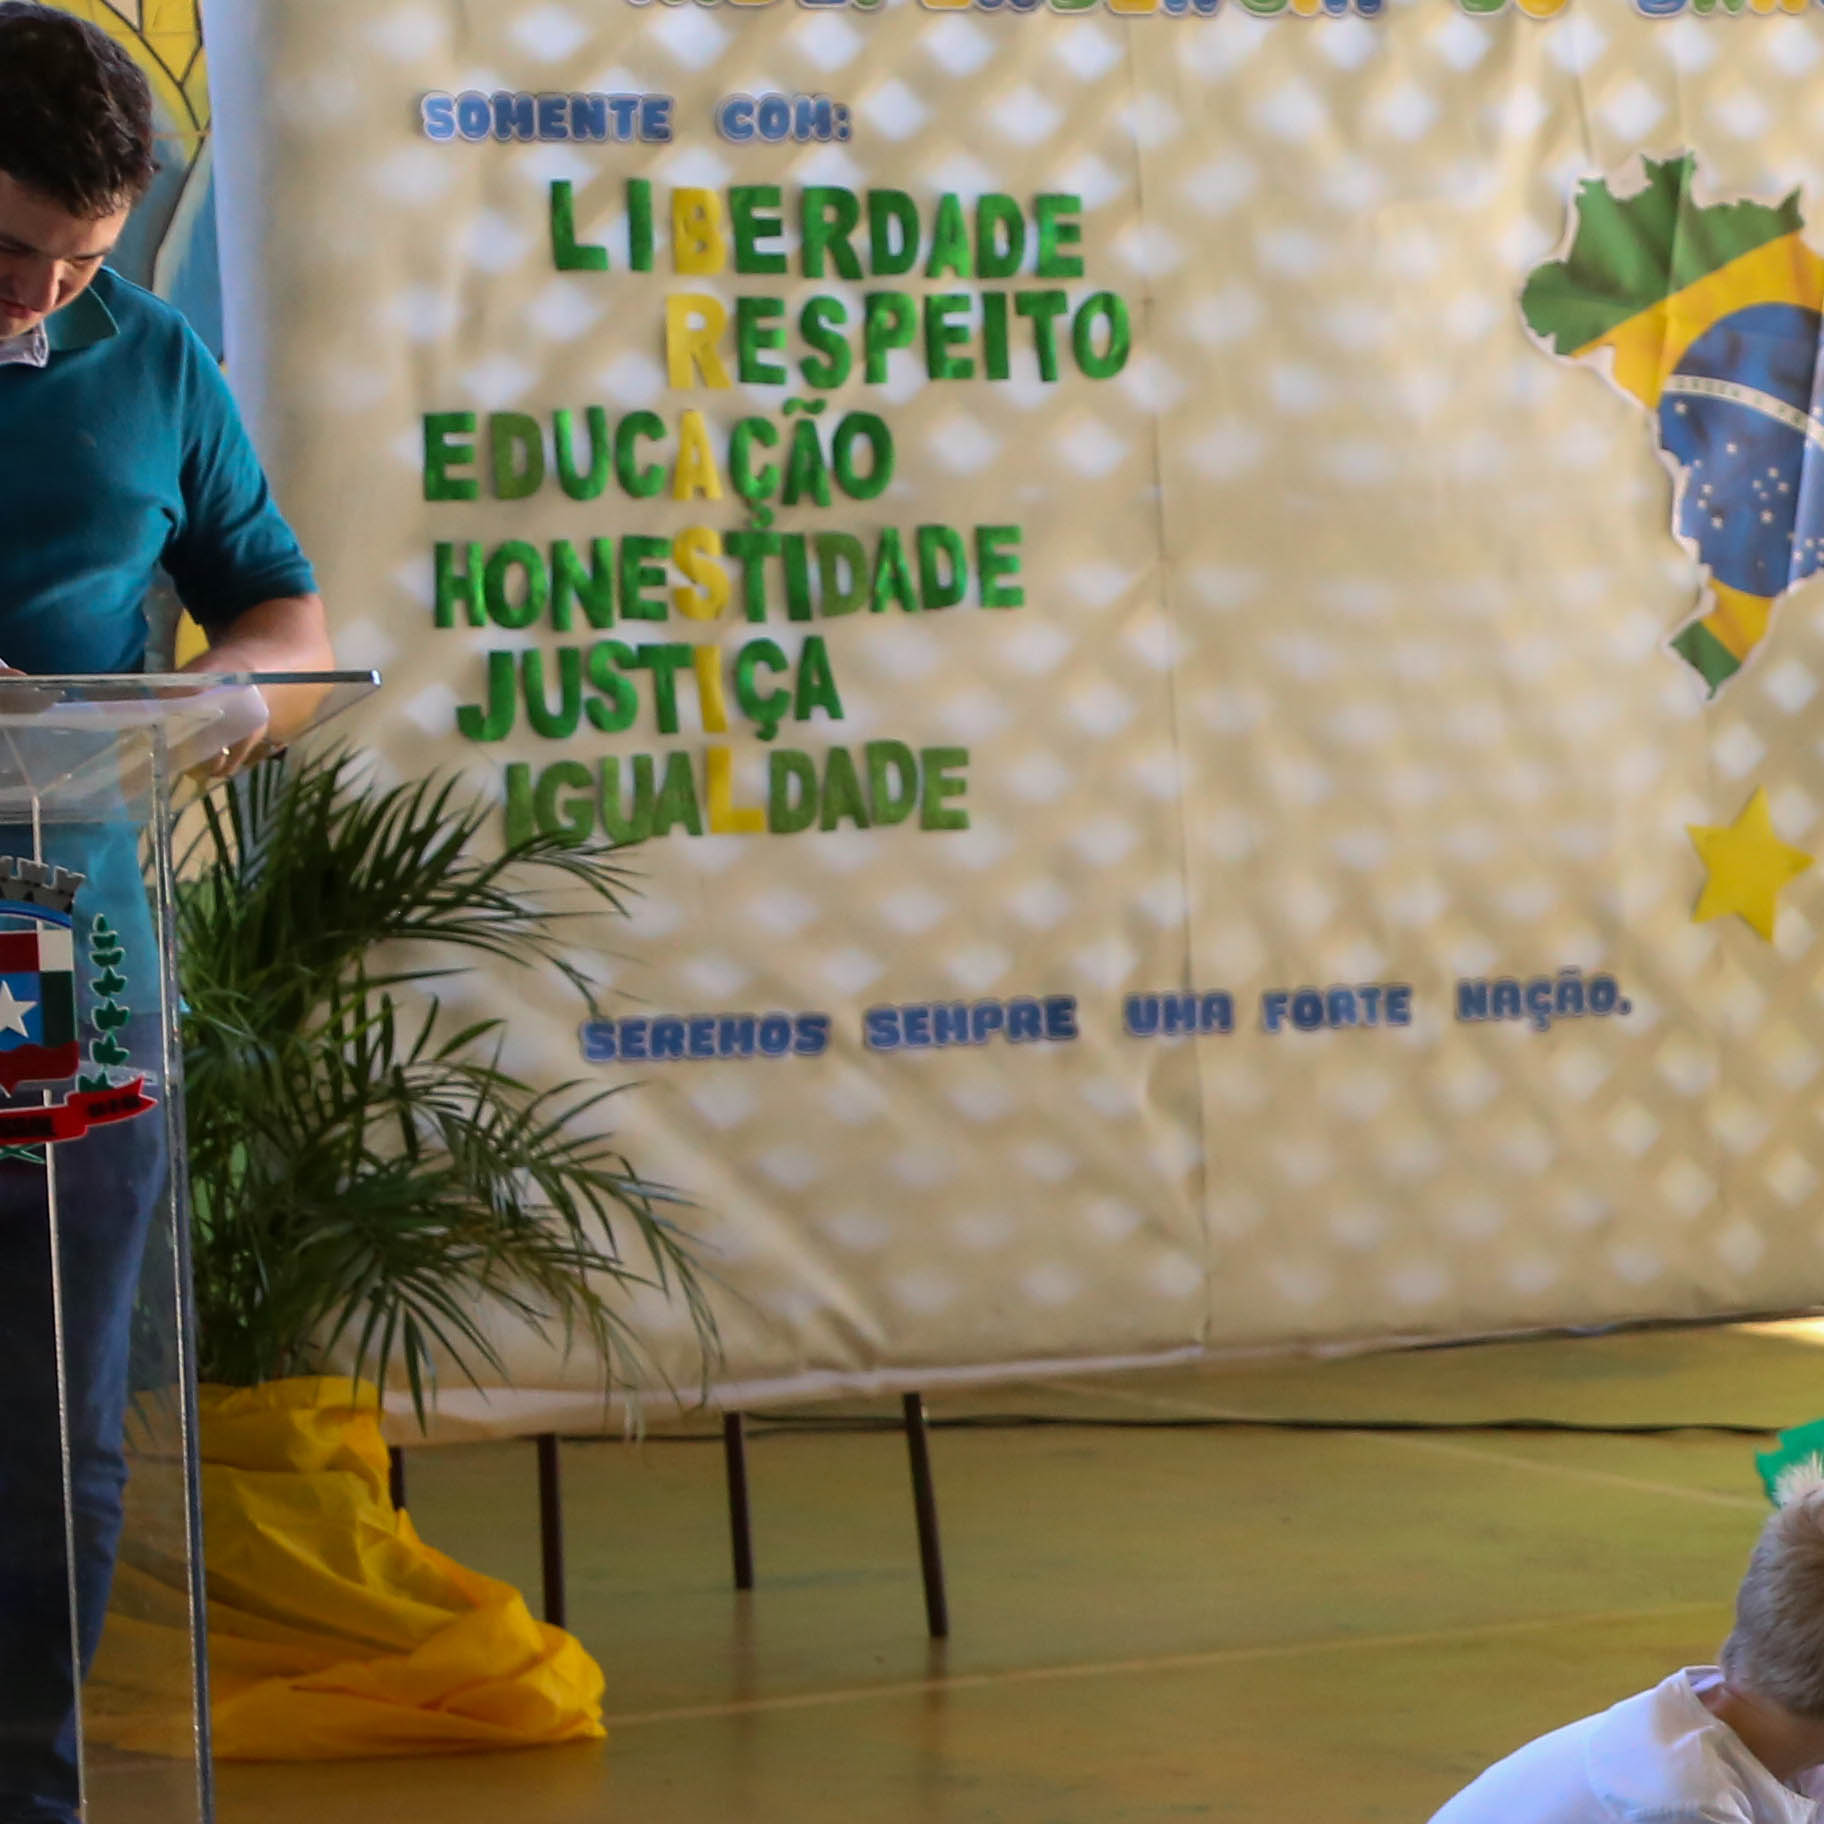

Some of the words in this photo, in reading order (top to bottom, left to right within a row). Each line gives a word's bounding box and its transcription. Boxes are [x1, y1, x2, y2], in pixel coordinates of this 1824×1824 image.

[420, 90, 673, 143] SOMENTE
[715, 92, 853, 143] COM:
[549, 178, 1085, 281] LIBERDADE
[666, 289, 1131, 390] RESPEITO
[422, 397, 896, 529] EDUCAÇÃO
[433, 524, 1026, 631] HONESTIDADE
[456, 634, 844, 742] JUSTIÇA
[504, 739, 971, 849] IGUALDADE
[578, 1014, 830, 1062] SEREMOS
[863, 994, 1078, 1050] SEMPRE
[1123, 990, 1234, 1037] UMA
[1262, 983, 1413, 1033] FORTE
[1455, 965, 1633, 1032] NAÇÃO.
